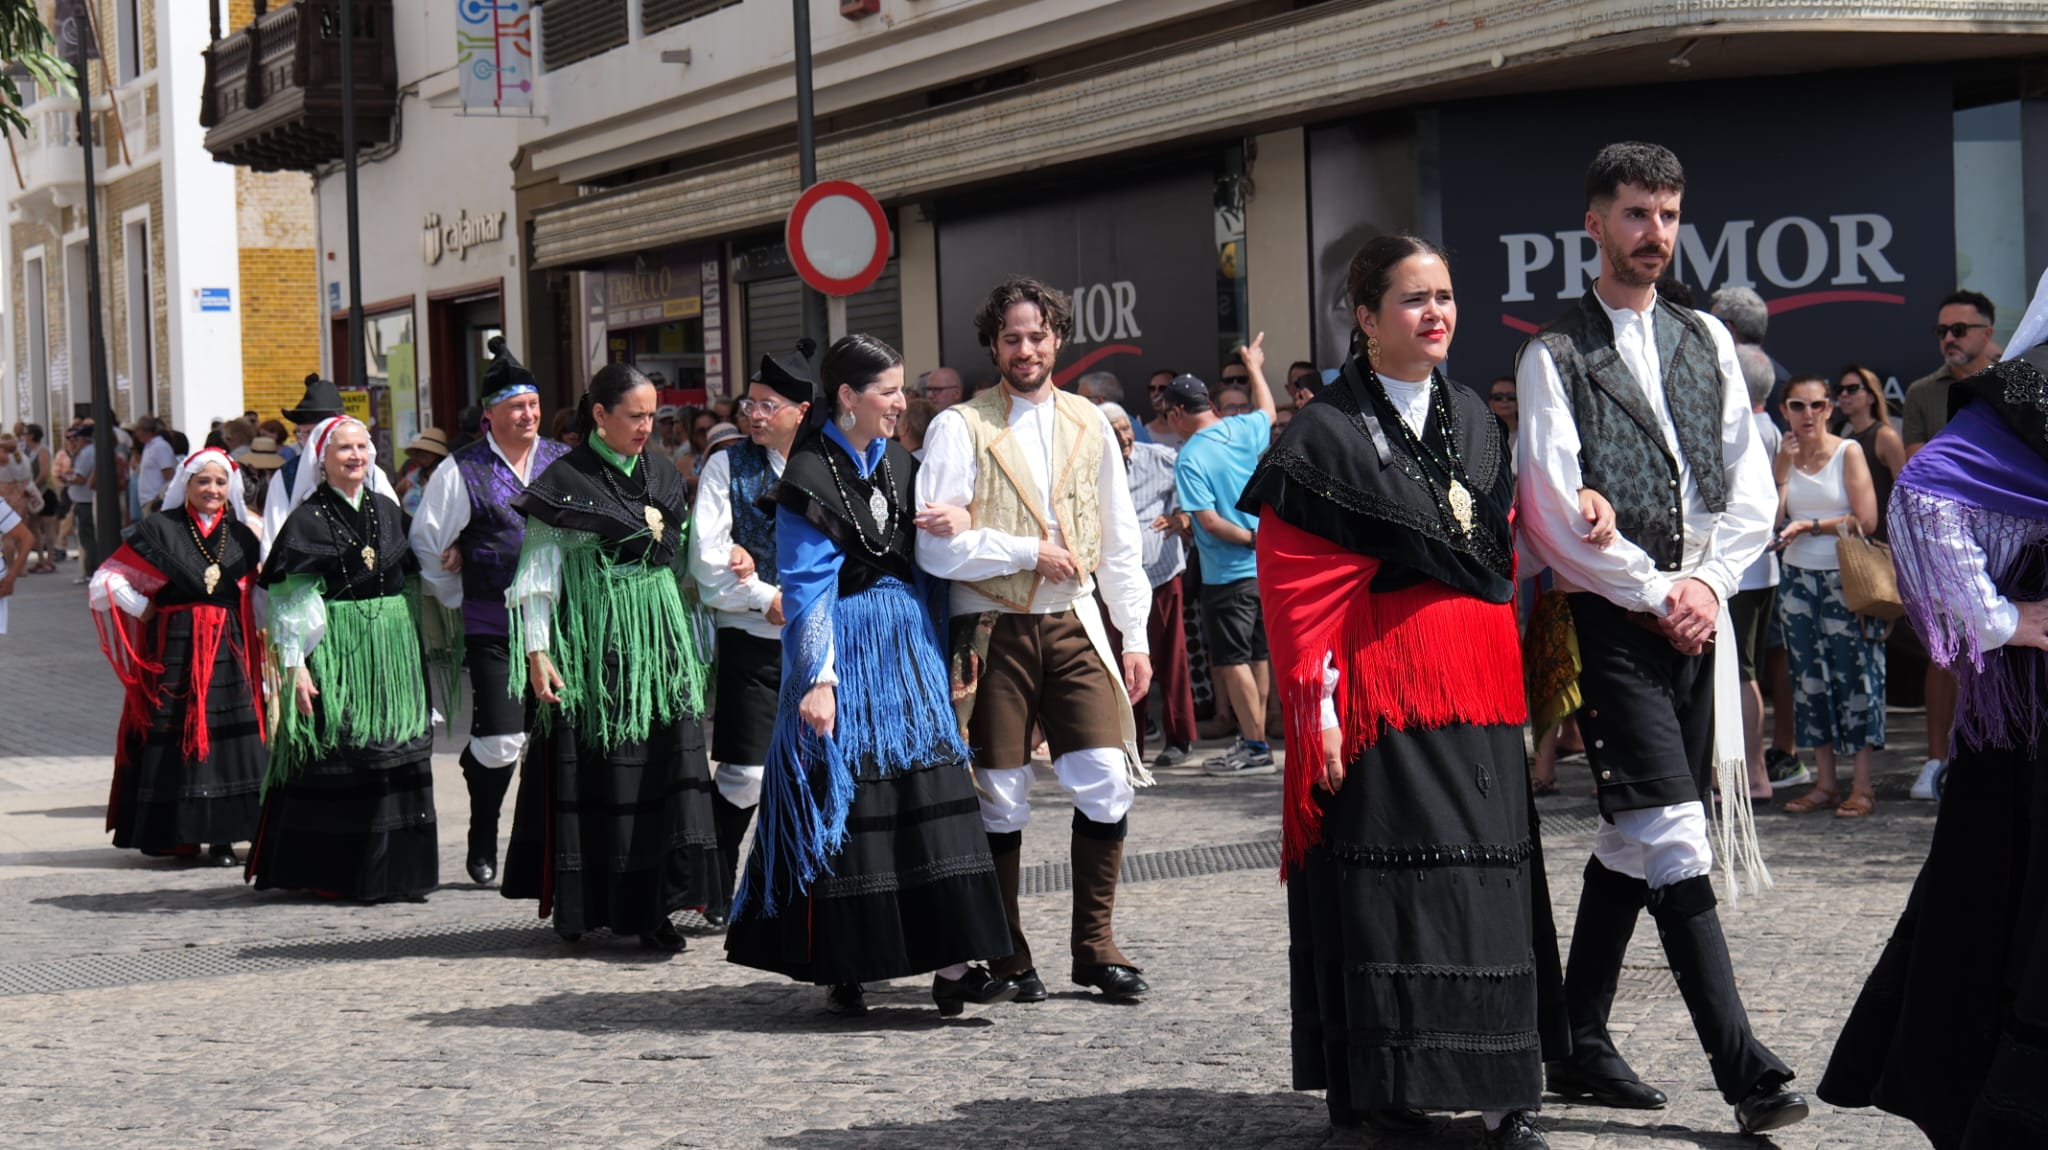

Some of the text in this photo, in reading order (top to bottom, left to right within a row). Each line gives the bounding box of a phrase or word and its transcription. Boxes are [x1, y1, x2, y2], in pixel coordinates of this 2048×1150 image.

[443, 209, 506, 261] cajamar
[1500, 213, 1905, 302] PRMOR
[1060, 280, 1142, 345] MOR
